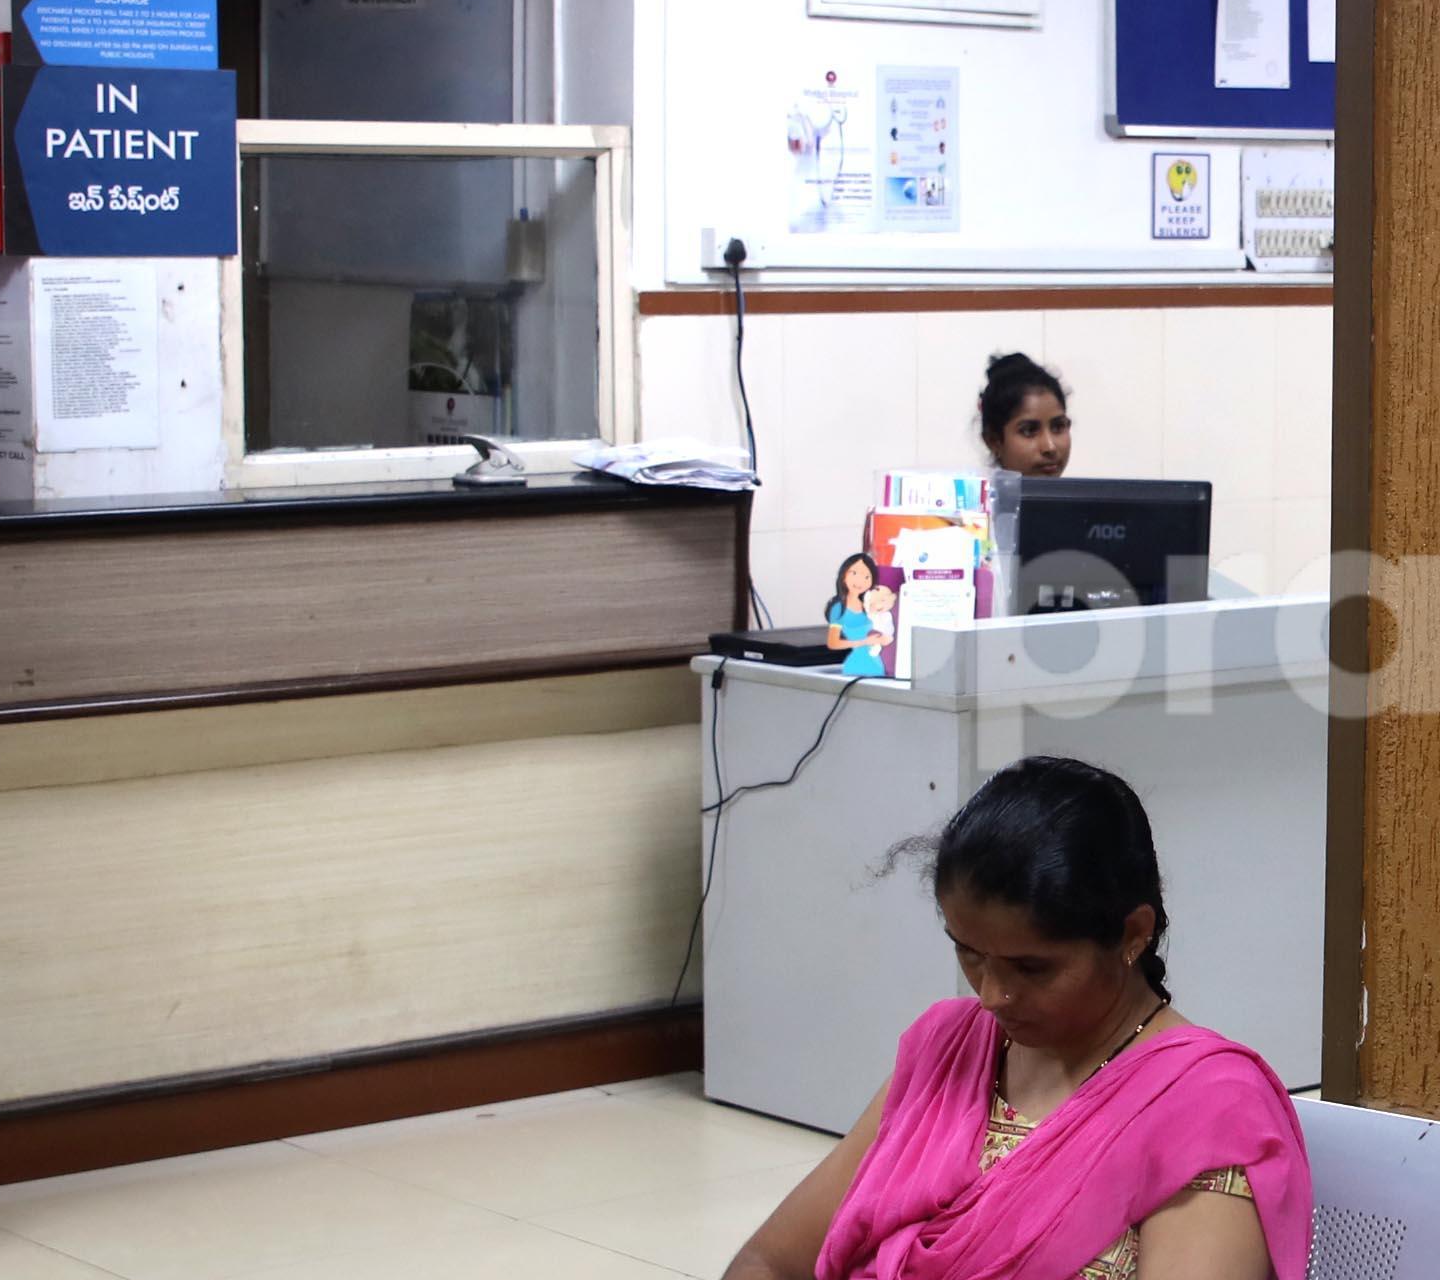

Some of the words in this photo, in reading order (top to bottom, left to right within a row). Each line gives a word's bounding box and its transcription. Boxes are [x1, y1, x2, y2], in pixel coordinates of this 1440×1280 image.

[97, 83, 138, 114] IN
[46, 128, 199, 160] PATIENT
[68, 185, 104, 212] ఇన్
[1088, 524, 1126, 539] AOC
